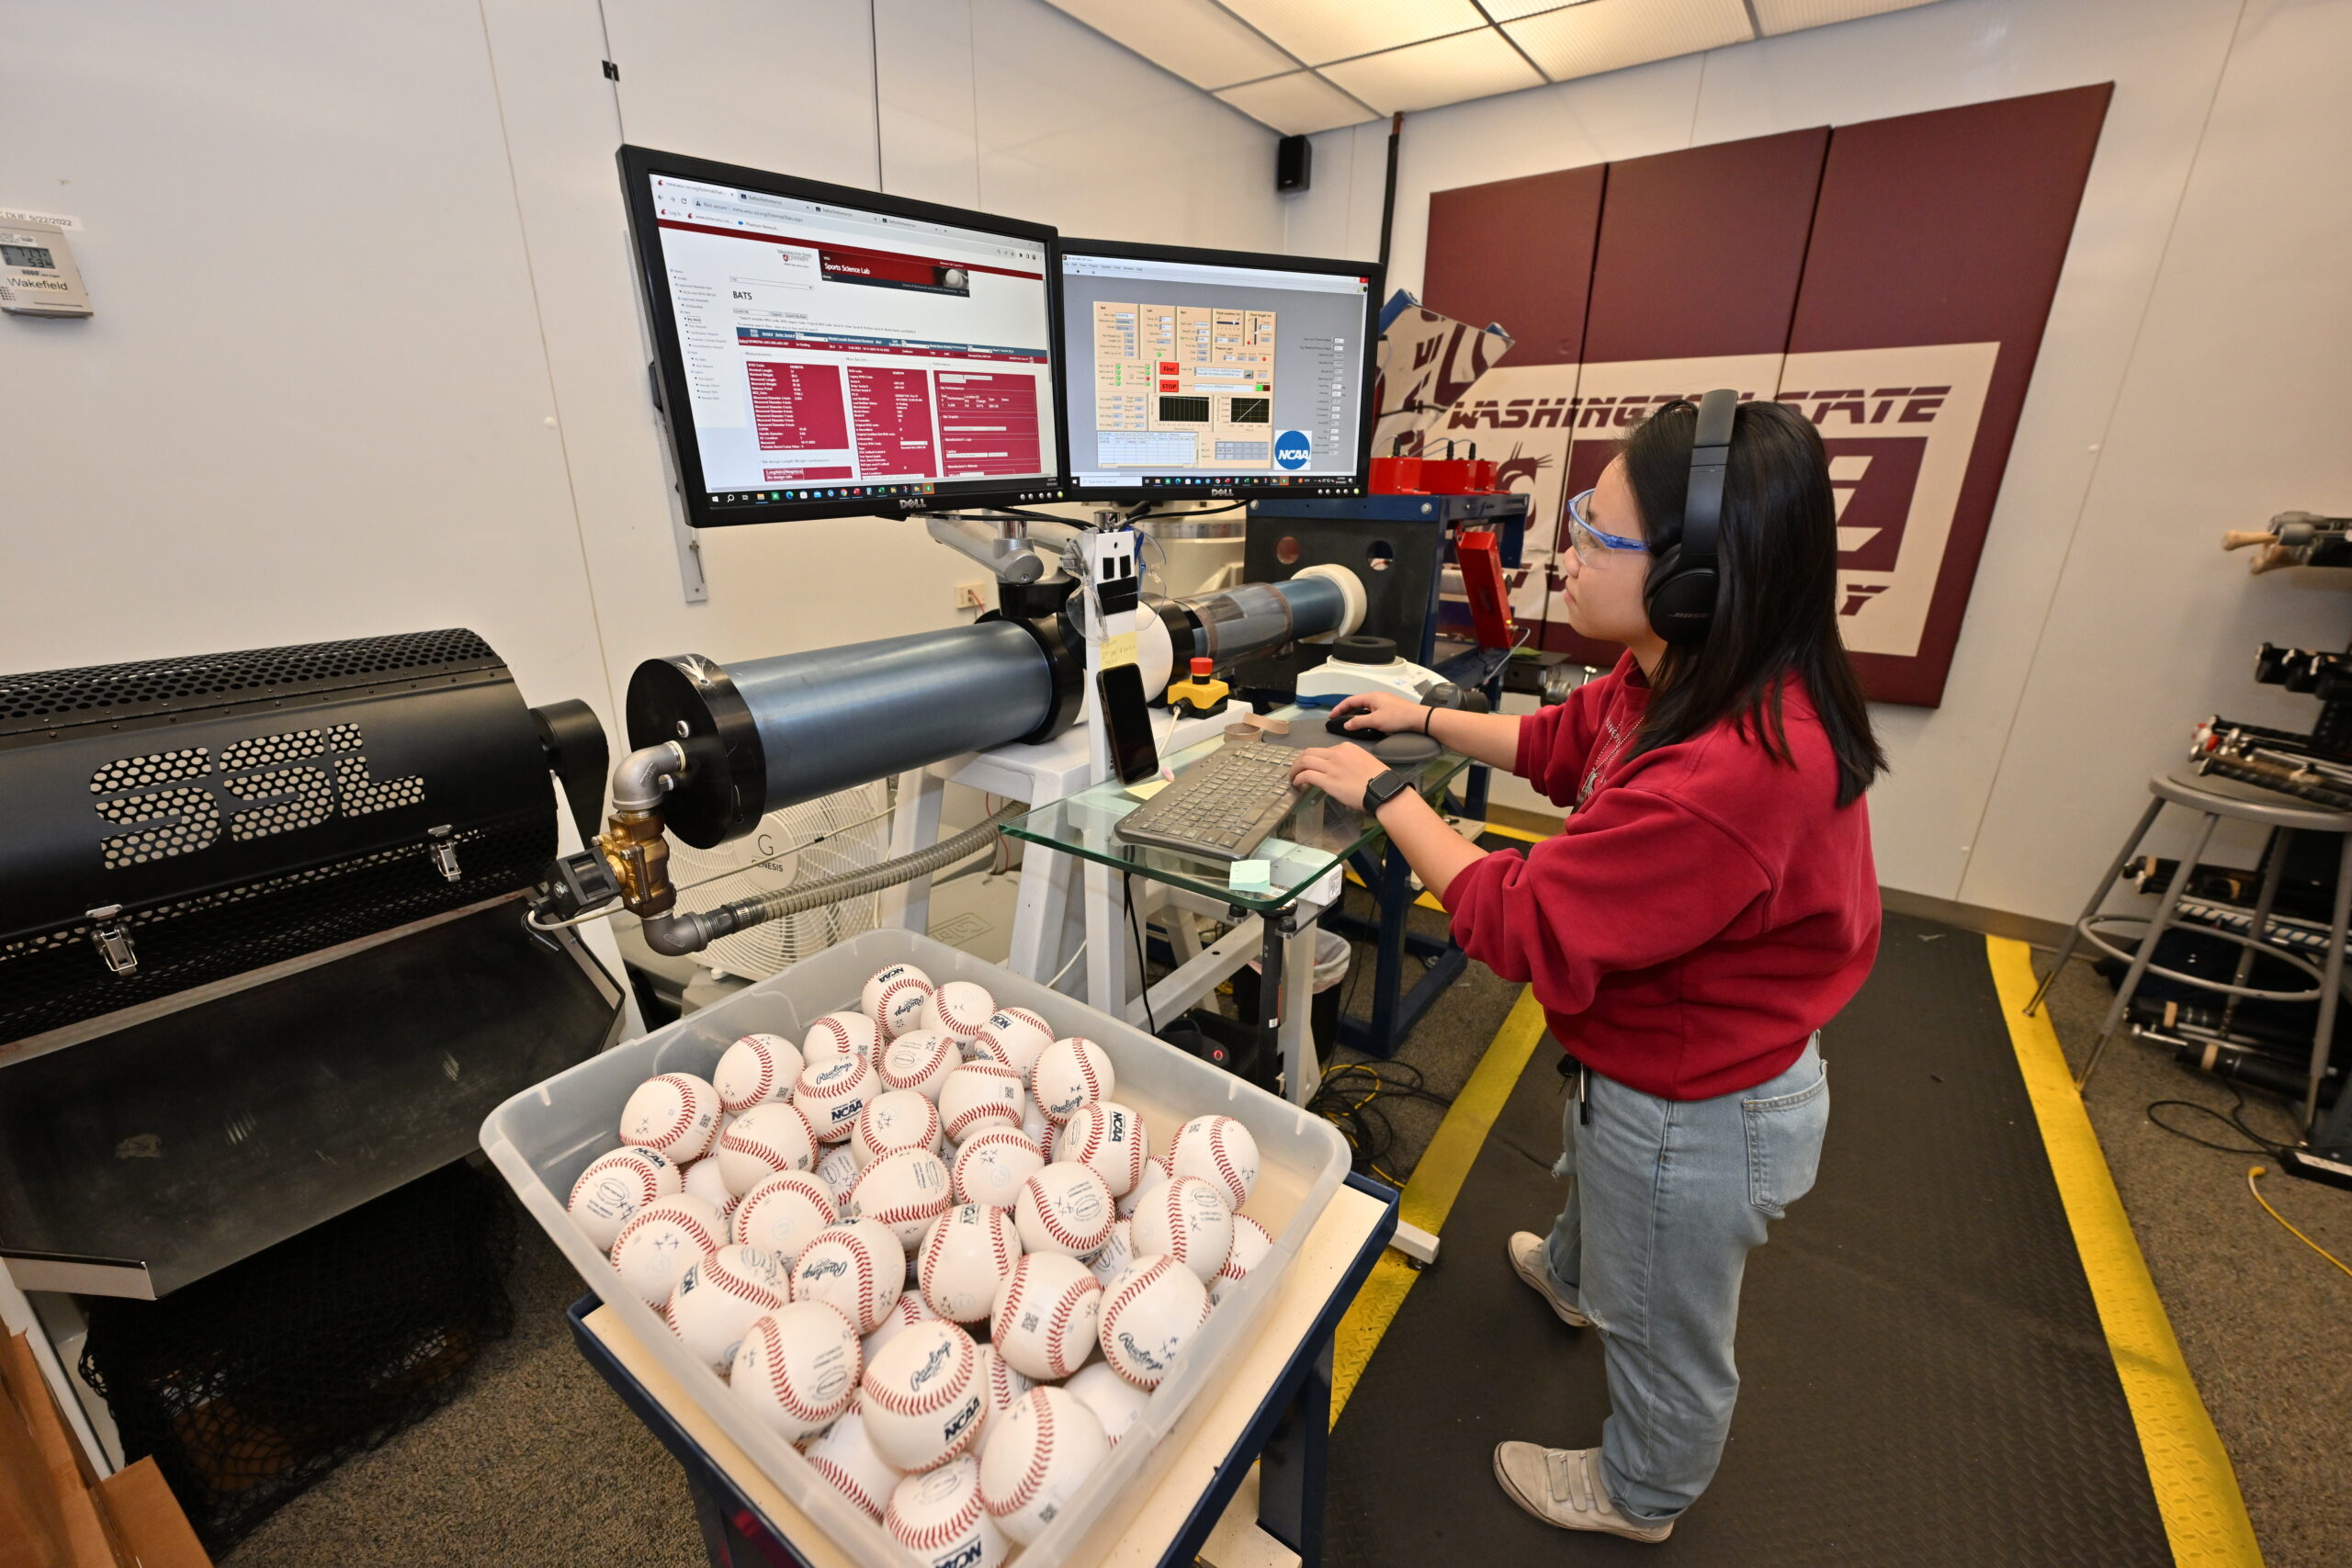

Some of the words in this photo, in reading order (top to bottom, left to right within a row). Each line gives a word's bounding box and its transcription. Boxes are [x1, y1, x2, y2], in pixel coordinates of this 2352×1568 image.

[825, 263, 842, 272] Sports
[842, 265, 860, 274] Science
[7, 277, 68, 290] Wakefield
[733, 291, 752, 300] BATS
[1447, 392, 1755, 430] WASHING
[1278, 449, 1309, 460] NCAA
[899, 498, 927, 510] DELL
[1211, 489, 1234, 497] DELL
[90, 722, 425, 870] SSL
[758, 834, 774, 856] G
[878, 967, 905, 983] NCAA
[894, 995, 924, 1017] Rawlings
[816, 1062, 853, 1085] Rawlings
[831, 1100, 864, 1122] NCAA
[1050, 1095, 1083, 1114] Rawlings
[1112, 1111, 1123, 1143] NCAA
[634, 1147, 666, 1168] NCAA
[802, 1261, 847, 1280] Rawlings
[1118, 1332, 1164, 1370] Rawlings
[910, 1341, 952, 1393] Rawlings
[944, 1395, 980, 1441] NCAA
[935, 1540, 982, 1568] NCA
